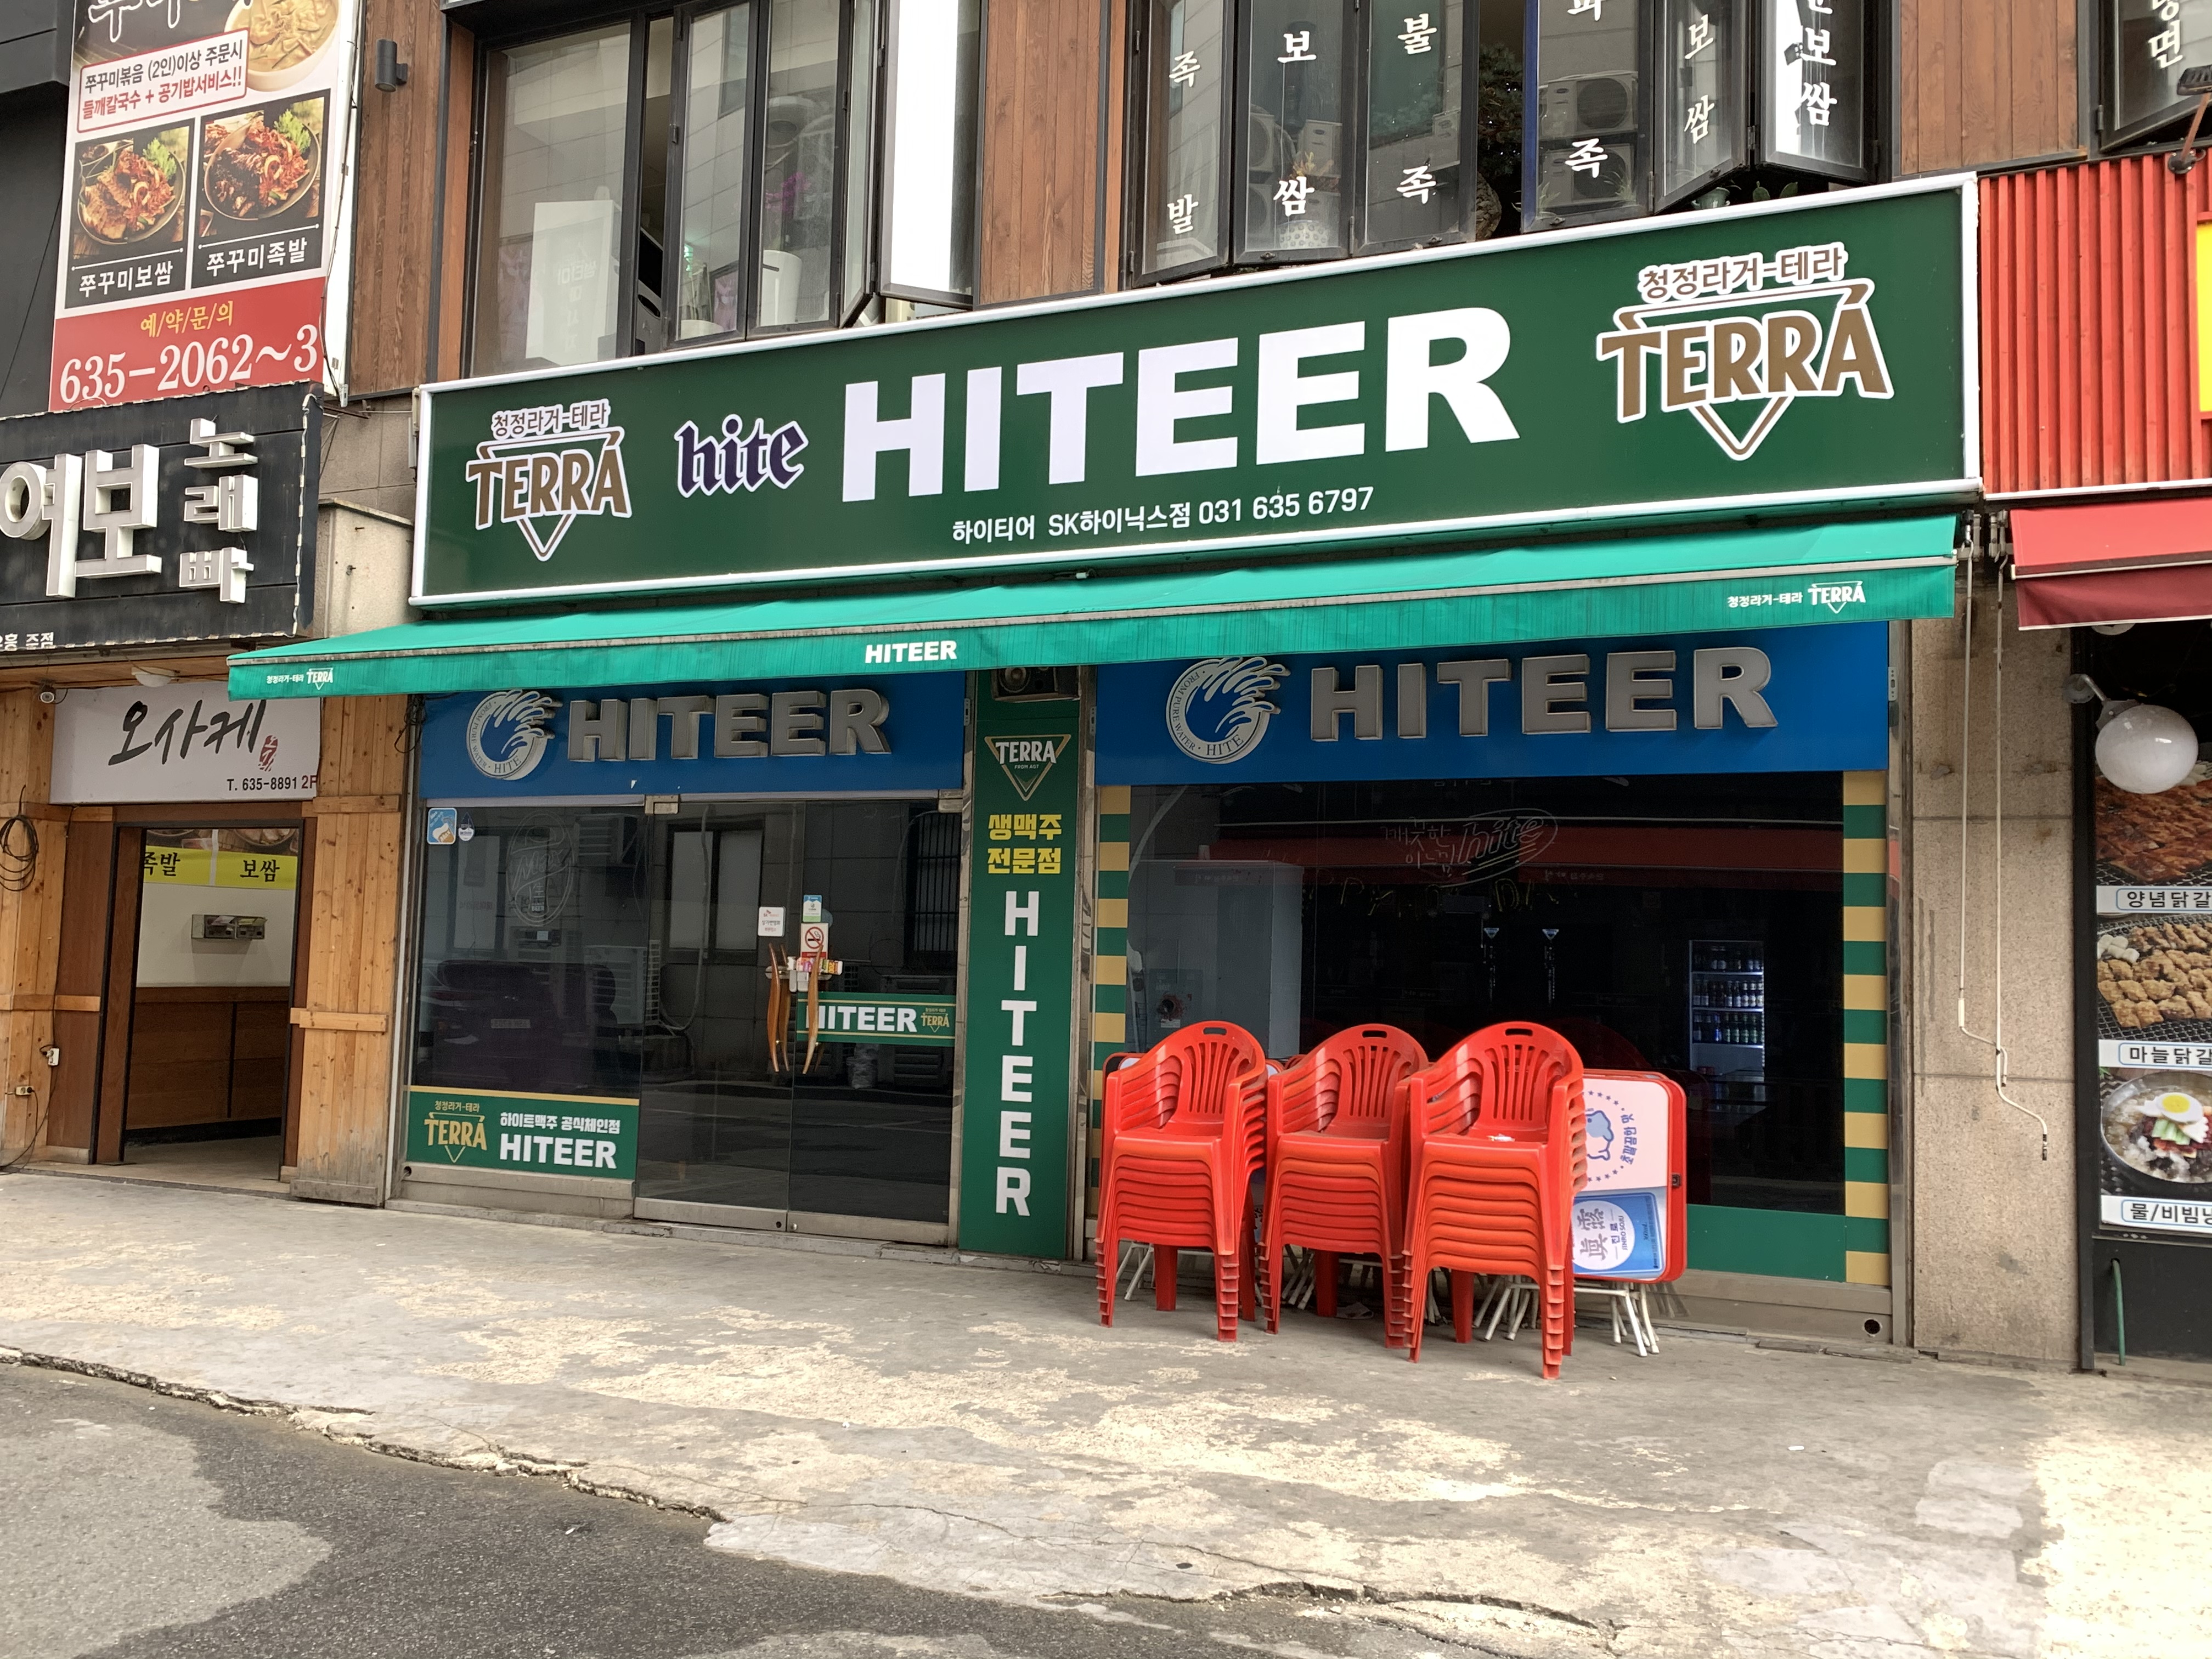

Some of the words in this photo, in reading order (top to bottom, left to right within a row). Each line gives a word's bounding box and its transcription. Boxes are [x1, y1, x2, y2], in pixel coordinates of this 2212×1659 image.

[148, 50, 202, 82] (2인)이상
[206, 40, 242, 66] 주문시
[82, 89, 141, 120] 들깨칼국수
[158, 66, 242, 104] 공기밥서비스!!
[206, 238, 307, 277] 쭈꾸미족발
[79, 261, 173, 297] 쭈꾸미보쌈
[1639, 242, 1848, 302] 청정라거-테라
[1596, 302, 1894, 423] TERRA
[492, 399, 610, 438] 청정라거-테라
[842, 307, 1520, 503] HITEER
[675, 414, 809, 498] hite
[466, 443, 632, 530] TERRA
[952, 514, 1036, 545] 하이티어
[1047, 502, 1192, 538] SK하이닉스점
[1198, 493, 1243, 526] 031
[1252, 491, 1301, 521] 635
[1307, 486, 1374, 516] 6797
[1728, 591, 1803, 608] 청정라거-테라
[1808, 583, 1866, 606] TERRA
[0, 633, 18, 651] 흥
[865, 640, 958, 664] HITEER
[306, 669, 333, 684] TERRA
[1178, 672, 1200, 695] FROM
[1311, 646, 1779, 742] HITEER
[1172, 696, 1182, 721] PURE
[108, 699, 266, 766] 오사케
[567, 689, 892, 762] HITEER
[1175, 723, 1195, 751] WATER
[995, 740, 1057, 764] TERRA
[1206, 734, 1244, 756] HITE
[494, 755, 521, 774] HITE
[227, 780, 238, 791] T.
[242, 777, 297, 791] 635-8891
[989, 814, 1062, 840] 생맥주
[240, 859, 280, 882] 보쌈
[988, 848, 1061, 874] 전문점
[2128, 891, 2212, 909] 양념닭갈
[921, 1014, 950, 1028] TERRA
[995, 890, 1040, 1217] HITEER
[2130, 1046, 2212, 1065] 마늘닭갈
[435, 1100, 480, 1113] 청정라거-테라
[424, 1118, 487, 1150] TERRA
[500, 1111, 557, 1128] 하이트맥주
[561, 1116, 620, 1135] 공식체인점
[500, 1133, 617, 1169] HITEER
